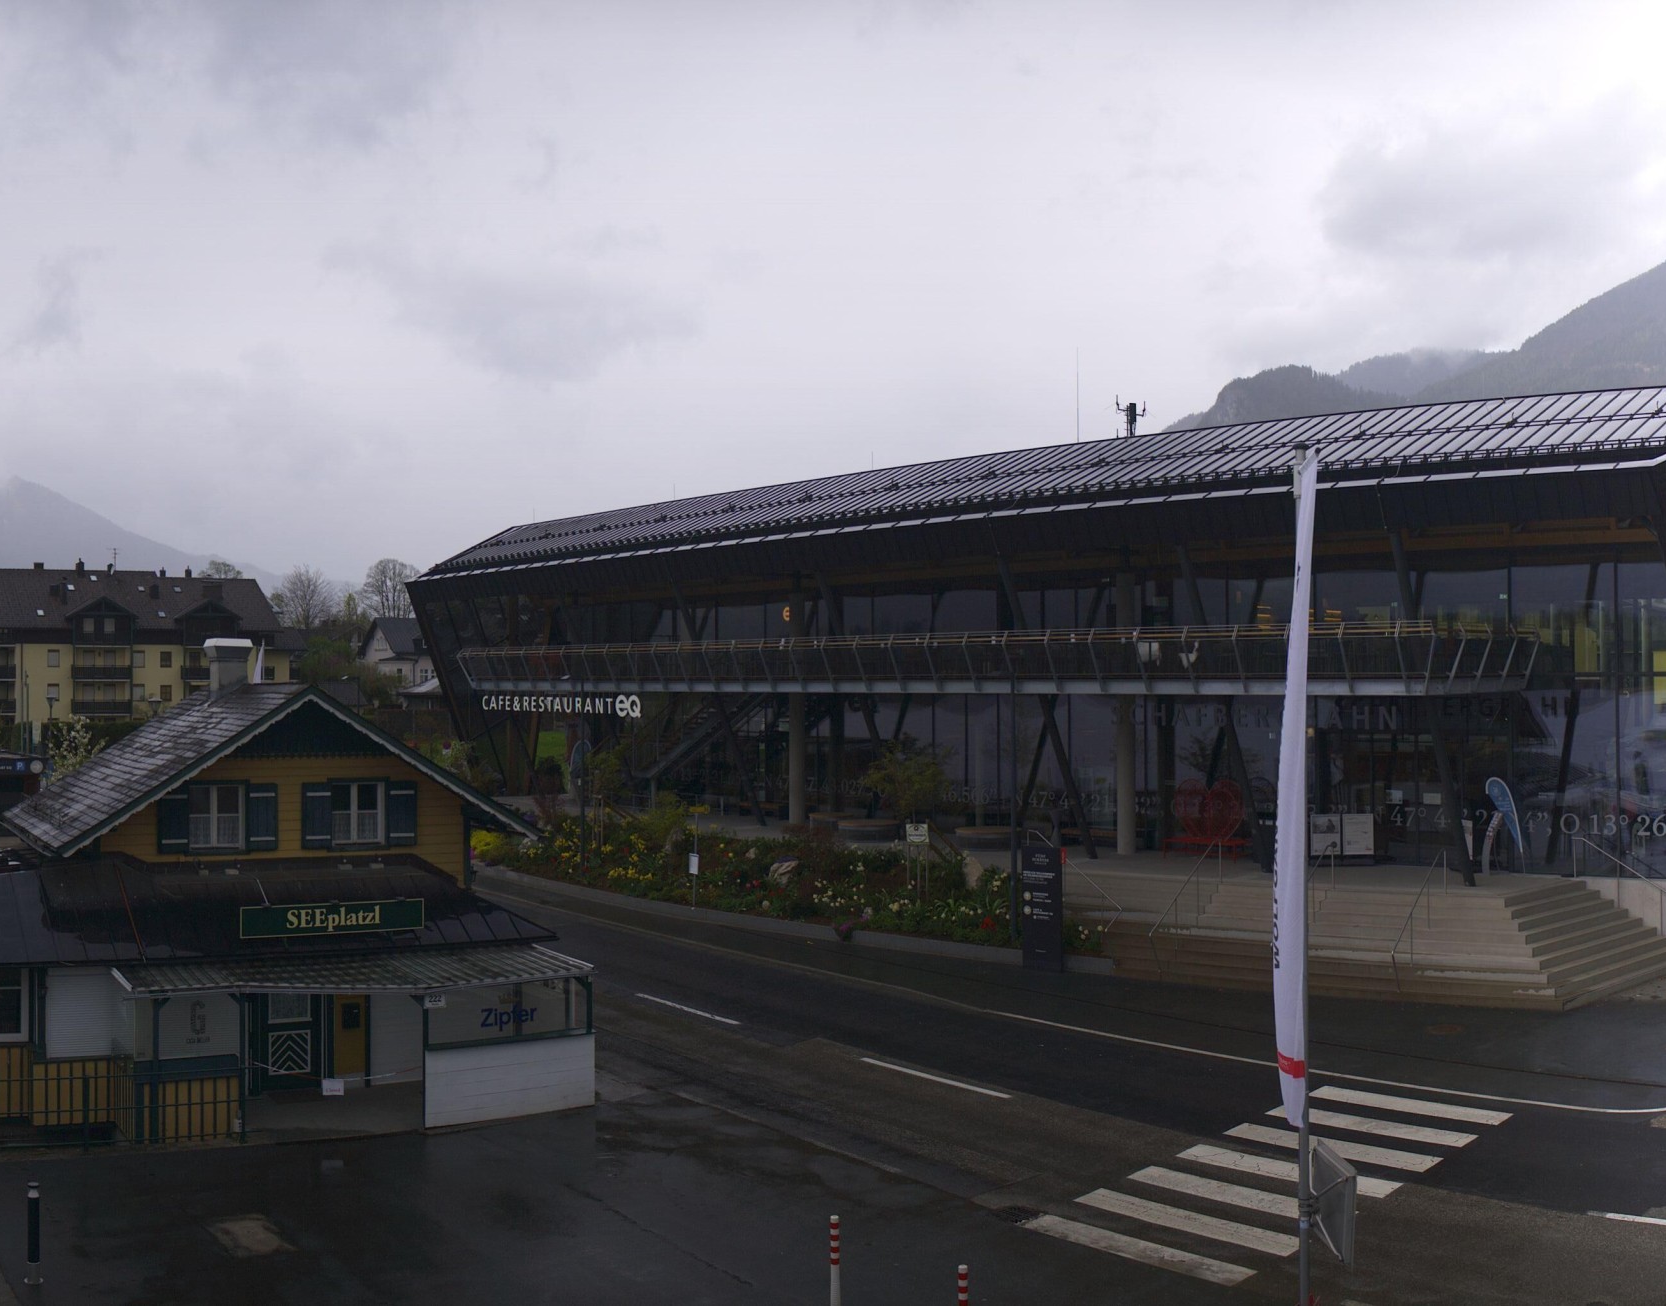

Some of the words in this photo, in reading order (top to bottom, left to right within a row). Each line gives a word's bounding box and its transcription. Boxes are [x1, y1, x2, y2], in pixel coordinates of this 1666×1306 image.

[1110, 703, 1398, 731] SCHAFBERAHN
[286, 905, 381, 932] SEEplatzl
[428, 995, 442, 1003] 222
[480, 1004, 537, 1032] Zipfer
